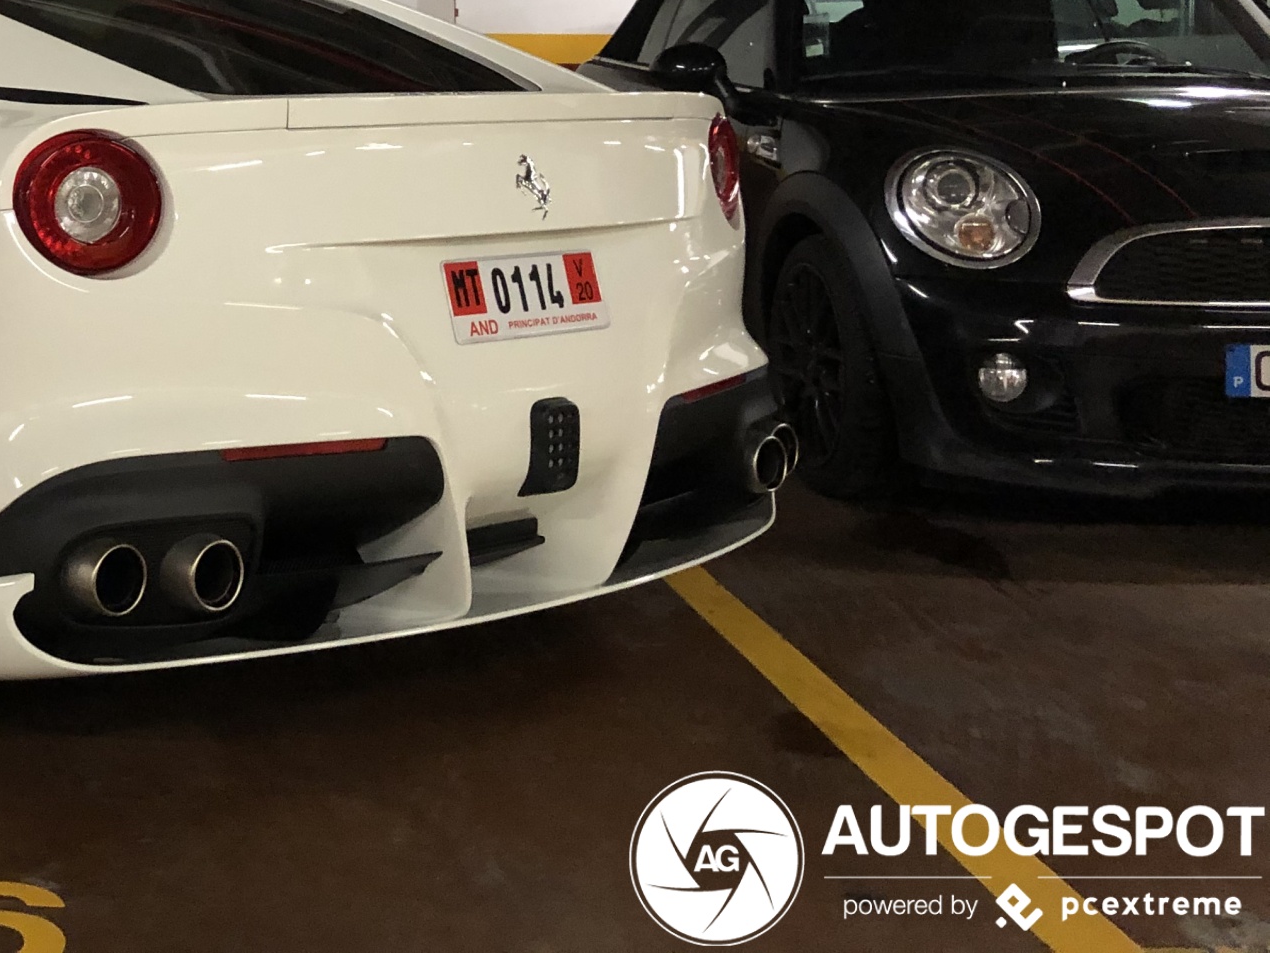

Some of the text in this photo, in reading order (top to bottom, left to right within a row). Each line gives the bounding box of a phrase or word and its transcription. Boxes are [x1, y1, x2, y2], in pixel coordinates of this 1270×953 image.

[572, 258, 584, 277] V
[450, 262, 564, 315] MT 0114
[575, 281, 595, 302] 20
[469, 312, 598, 337] AND PRINCIPAT D'ANDORRA
[1233, 376, 1244, 388] P
